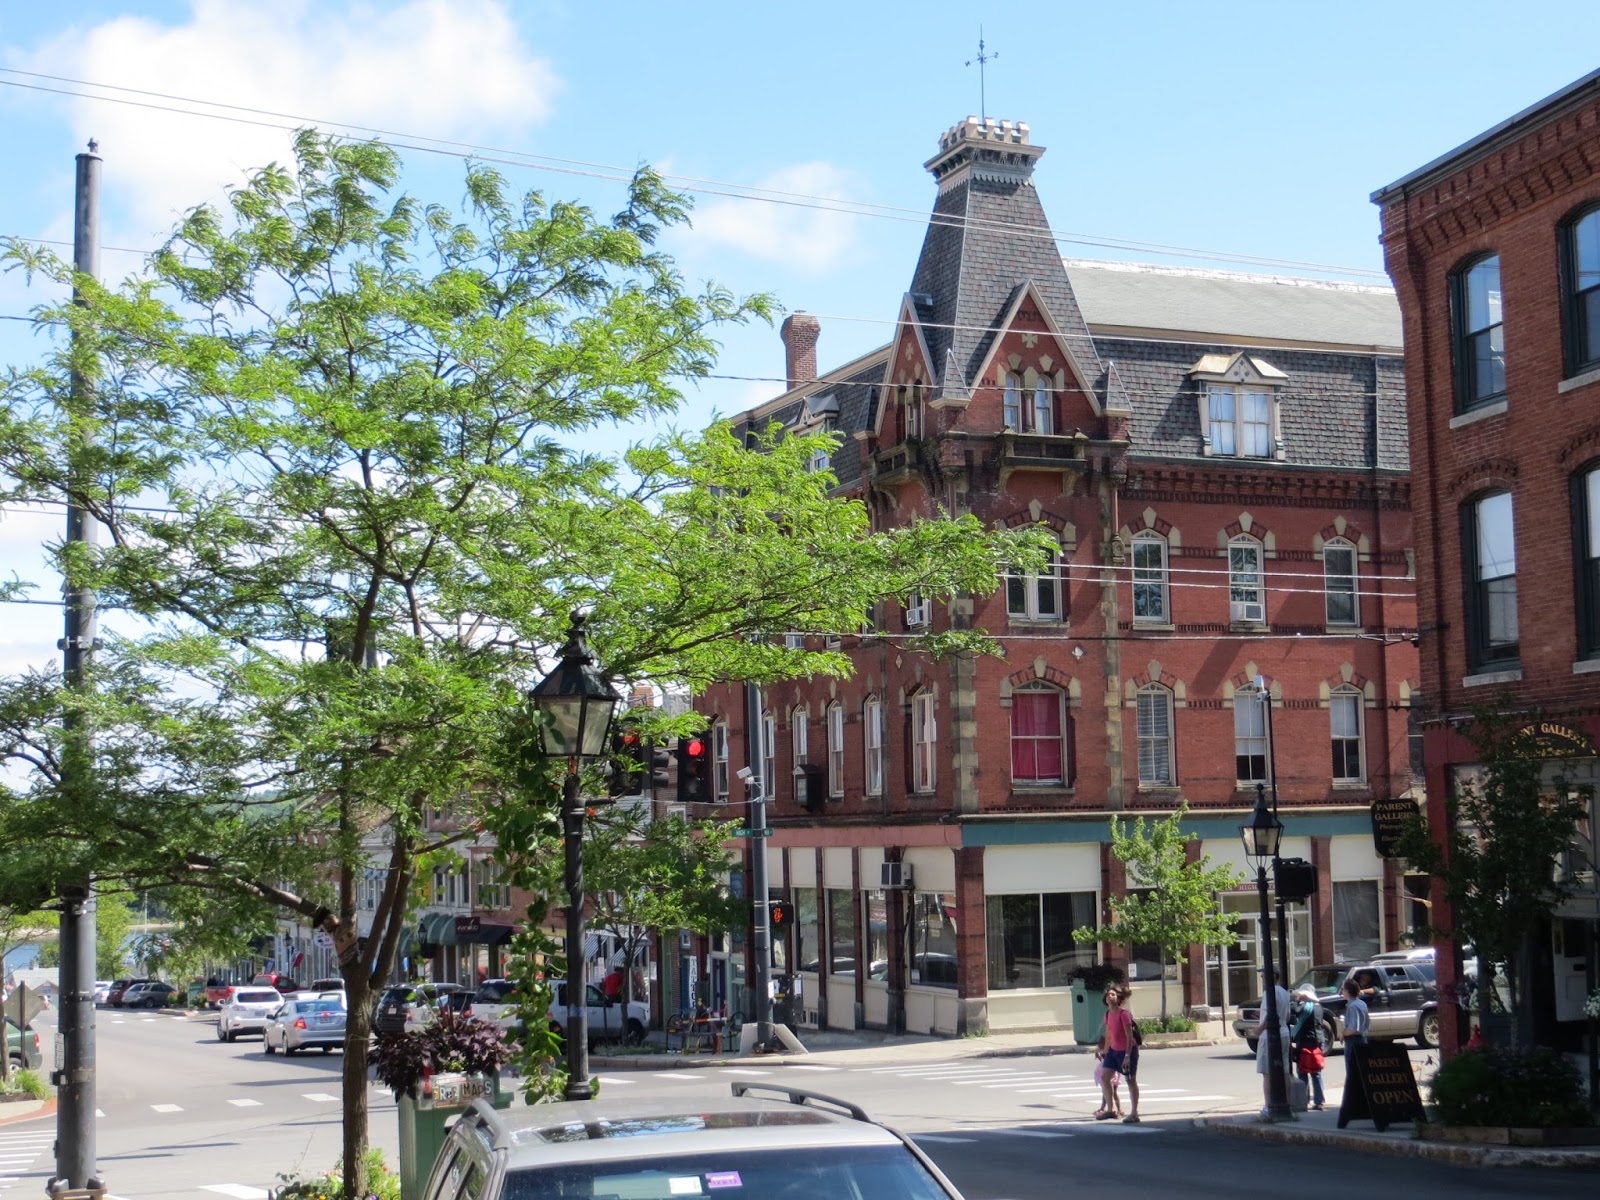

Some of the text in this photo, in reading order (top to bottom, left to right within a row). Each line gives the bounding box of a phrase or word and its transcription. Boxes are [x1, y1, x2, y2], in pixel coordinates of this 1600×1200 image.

[1376, 802, 1412, 811] PARENT
[1239, 883, 1258, 891] HIGH
[1367, 1057, 1401, 1068] PARENT
[1368, 1072, 1409, 1085] GALLERY
[463, 1081, 492, 1097] MAPS
[1373, 1088, 1415, 1105] OPEN
